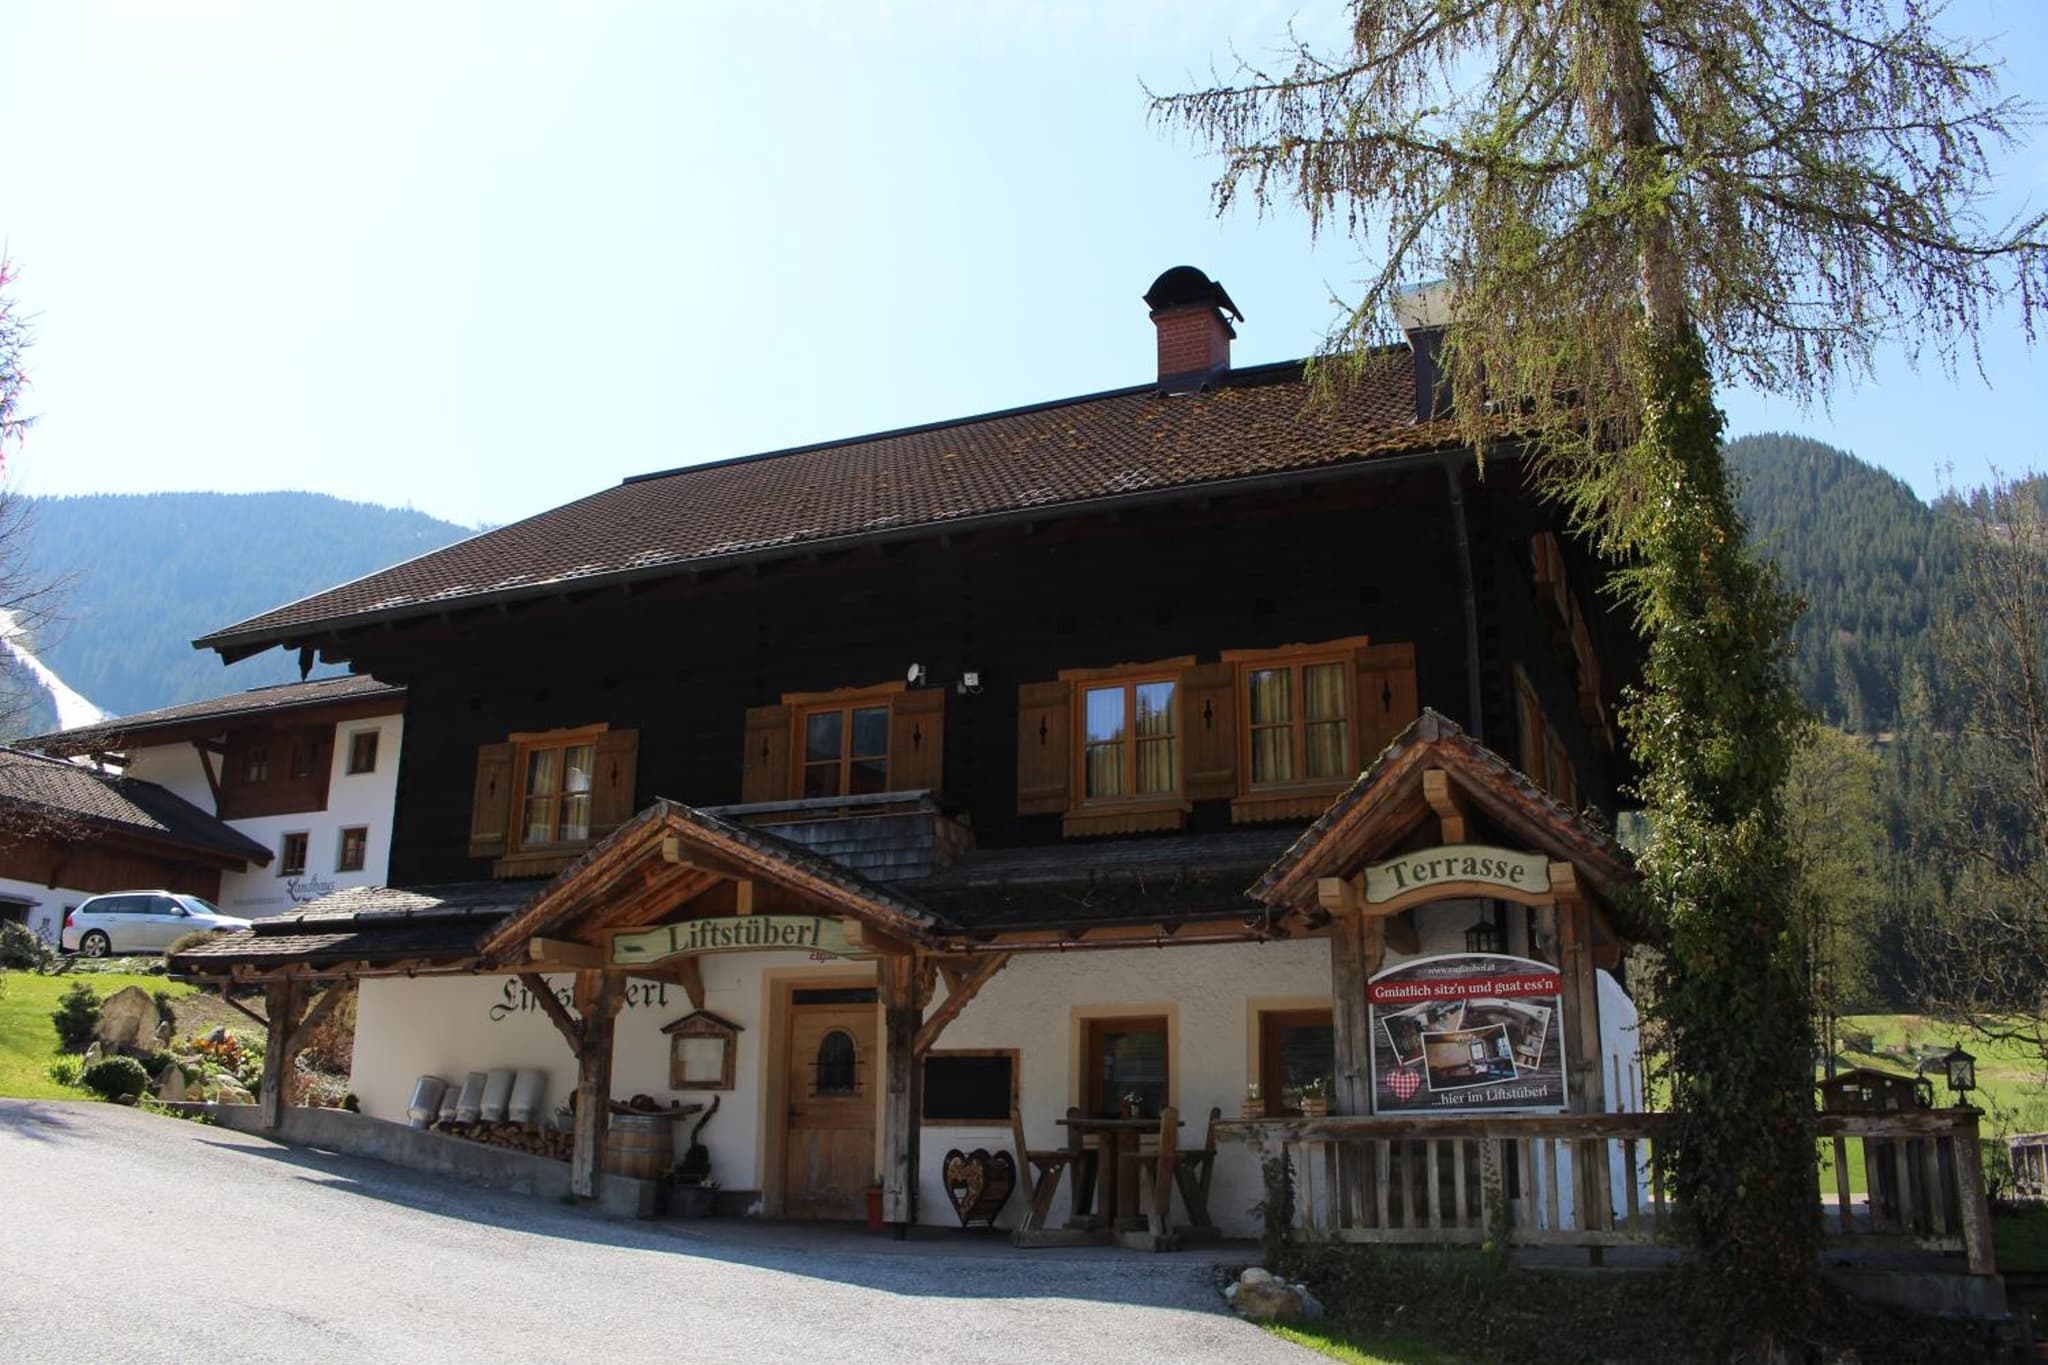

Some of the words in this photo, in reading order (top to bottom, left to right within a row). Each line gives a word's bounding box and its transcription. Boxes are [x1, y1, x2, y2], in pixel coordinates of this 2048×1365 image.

[1386, 855, 1526, 891] Terrasse
[668, 918, 821, 953] Liftstüberl
[1375, 984, 1431, 998] Gmiatlich
[1434, 982, 1465, 995] sitz'n
[1469, 981, 1491, 993] und
[1494, 980, 1521, 993] guat
[1524, 978, 1553, 990] ess'n
[1467, 1090, 1483, 1103] im
[1486, 1084, 1548, 1101] Liftstüberl
